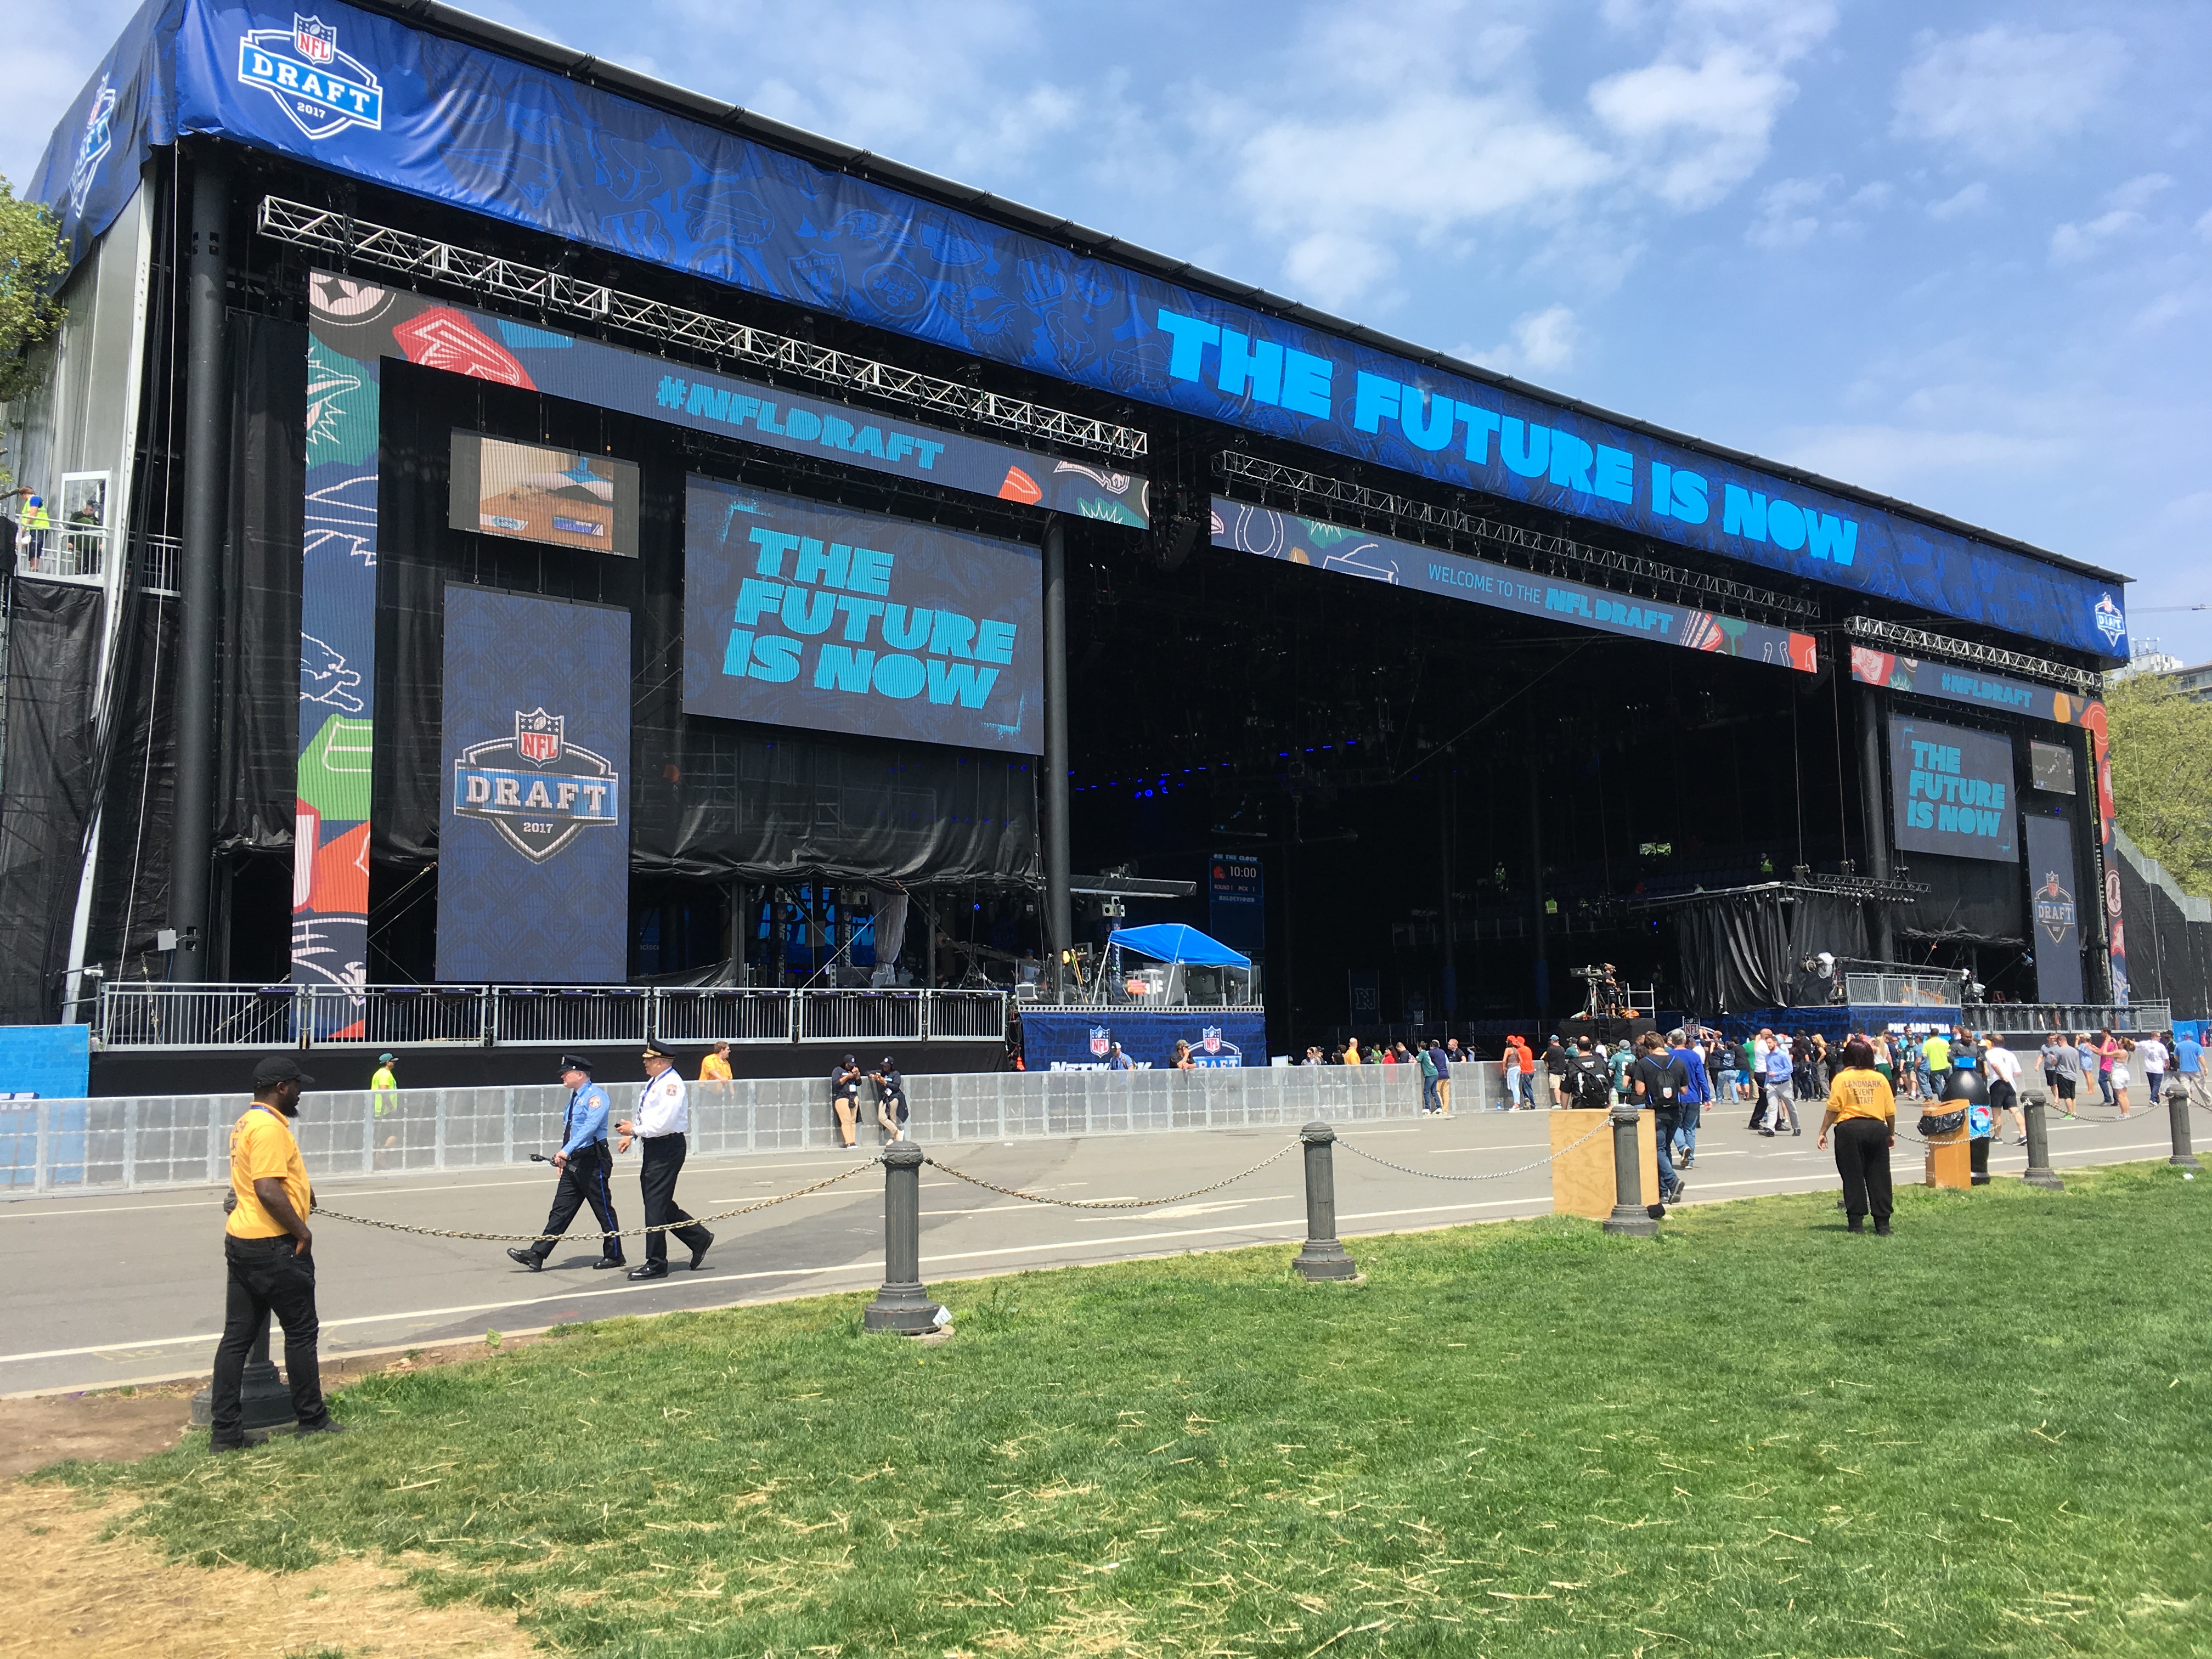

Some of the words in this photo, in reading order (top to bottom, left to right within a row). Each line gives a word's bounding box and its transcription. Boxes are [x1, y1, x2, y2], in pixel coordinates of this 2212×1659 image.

[300, 32, 329, 58] NFL
[252, 53, 370, 112] DRAFT
[297, 102, 326, 119] 2017
[656, 375, 945, 470] #NFLDRAFT
[1157, 308, 1333, 420] THE
[1353, 370, 1633, 505] FUTURE
[1651, 461, 1708, 524] IS
[1723, 483, 1858, 566] NOW
[748, 526, 895, 596] THE
[1428, 563, 1493, 594] WELCOME
[1497, 580, 1513, 598] TO
[1516, 583, 1541, 604] THE
[1544, 586, 1592, 618] NFL
[1594, 600, 1673, 635] DRAFT
[734, 578, 1017, 665] FUTURE
[721, 628, 804, 683] IS
[814, 644, 1000, 709] NOW
[1941, 673, 2033, 708] #NFLDRAFT
[521, 732, 558, 761] NFL
[1911, 740, 1961, 774] THE
[466, 774, 607, 811] DRAFT
[1909, 770, 2006, 810] FUTURE
[523, 822, 554, 834] 2017
[1907, 799, 1934, 829] IS
[1938, 803, 2002, 837] NOW
[1231, 866, 1256, 878] 10:00
[2038, 905, 2072, 920] DRAFT
[1206, 1038, 1219, 1048] NFL
[1685, 1024, 1698, 1034] NFL
[1093, 1039, 1108, 1053] NFL
[1906, 1051, 1915, 1062] 11
[1843, 1080, 1882, 1088] LANDMARK
[1855, 1096, 1874, 1104] STAFF
